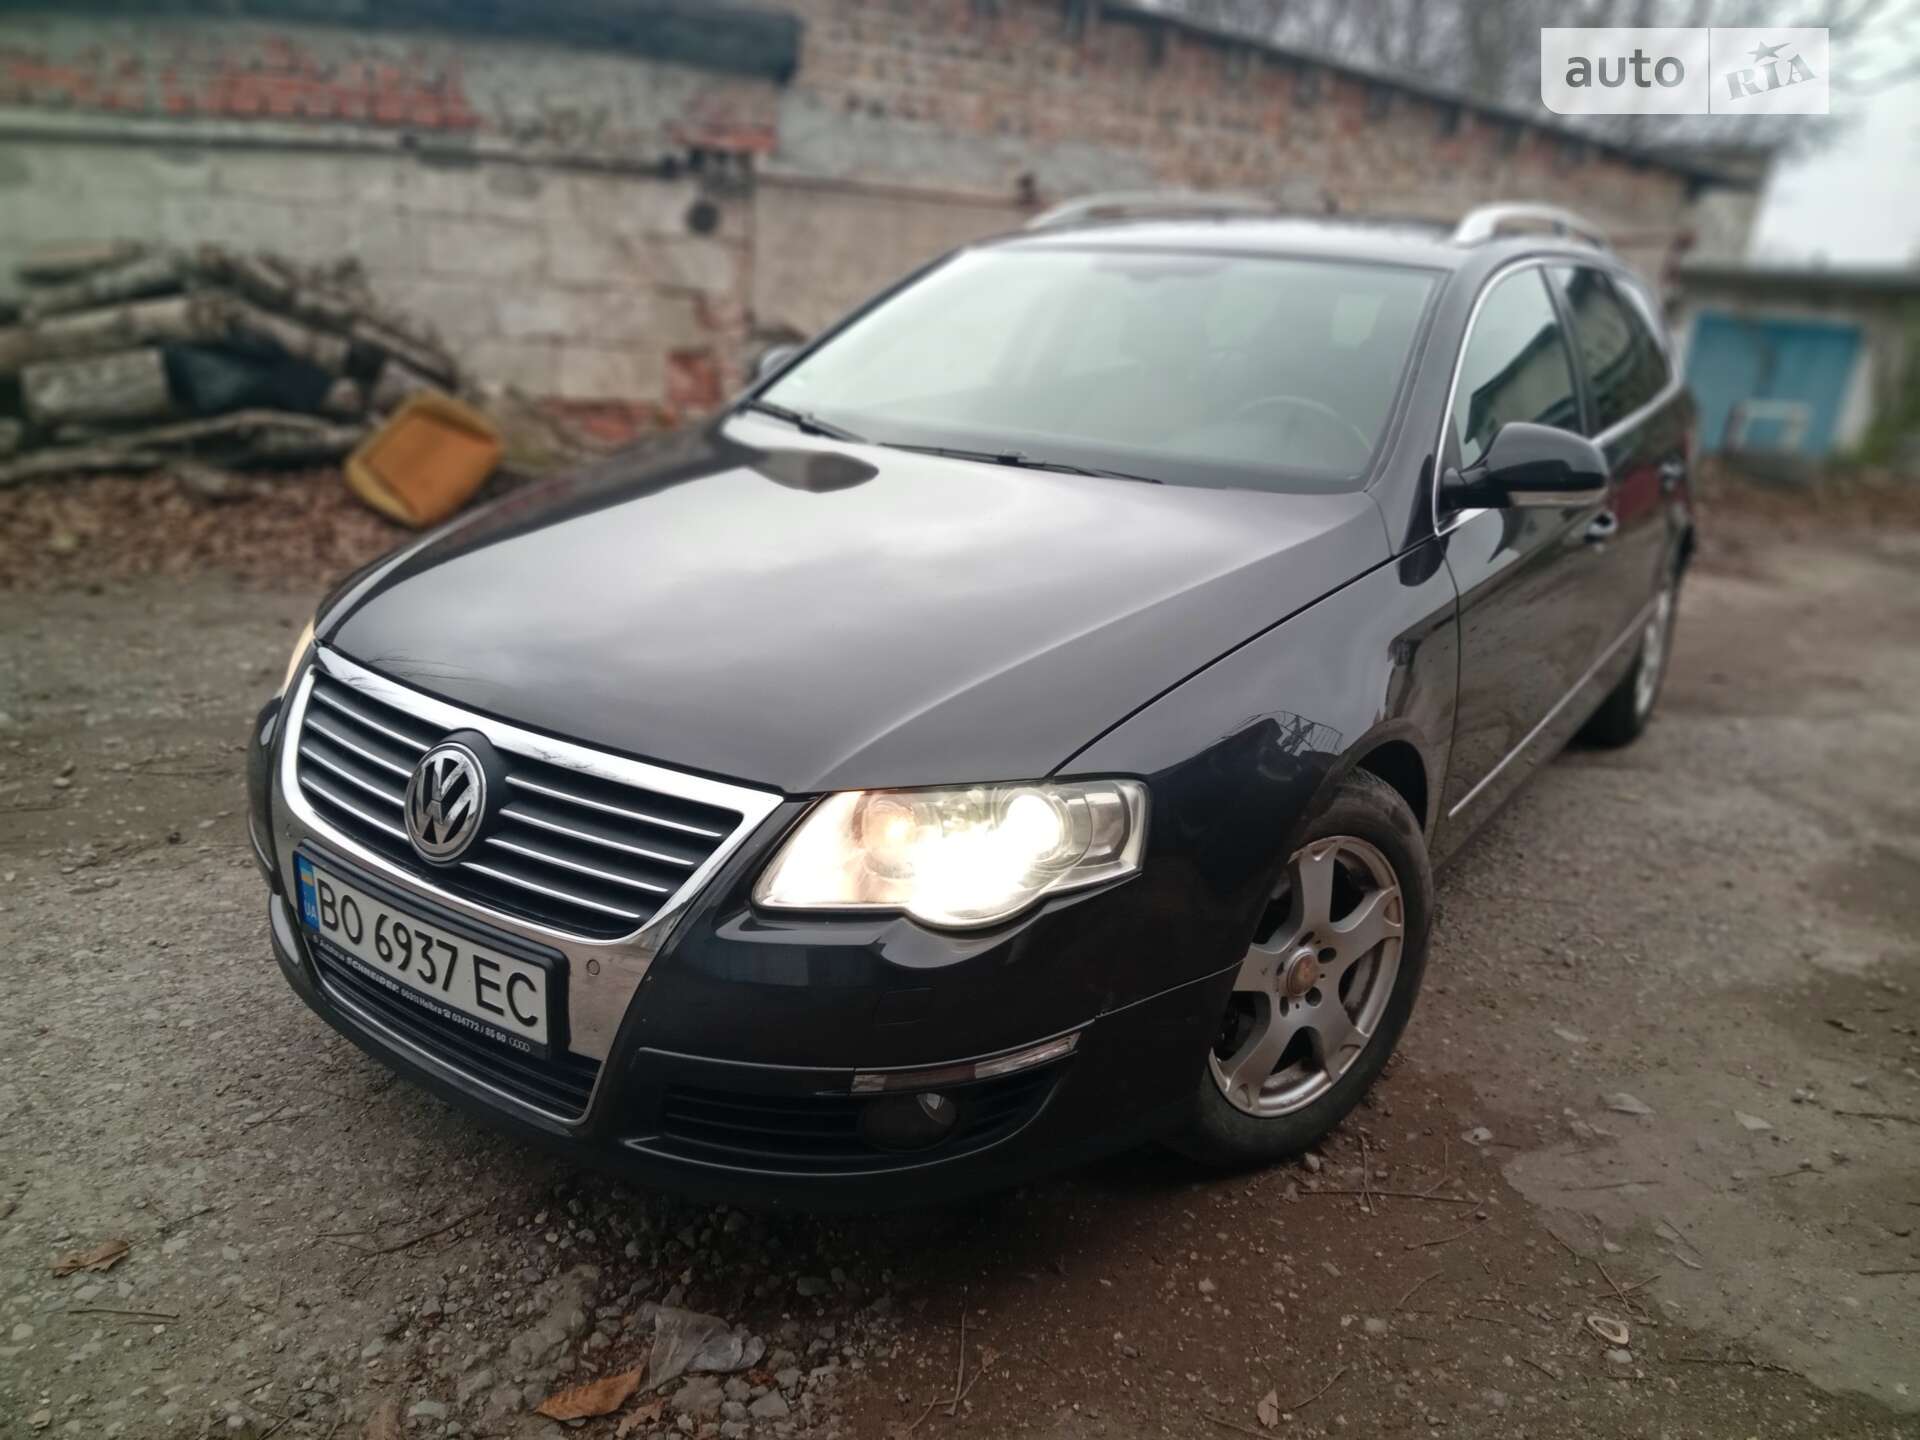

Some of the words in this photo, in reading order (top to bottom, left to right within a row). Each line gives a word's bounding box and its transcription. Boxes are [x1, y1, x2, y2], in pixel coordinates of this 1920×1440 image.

[304, 901, 317, 920] UA
[318, 878, 363, 945] BO
[374, 913, 458, 992] 6937
[473, 954, 538, 1028] EC
